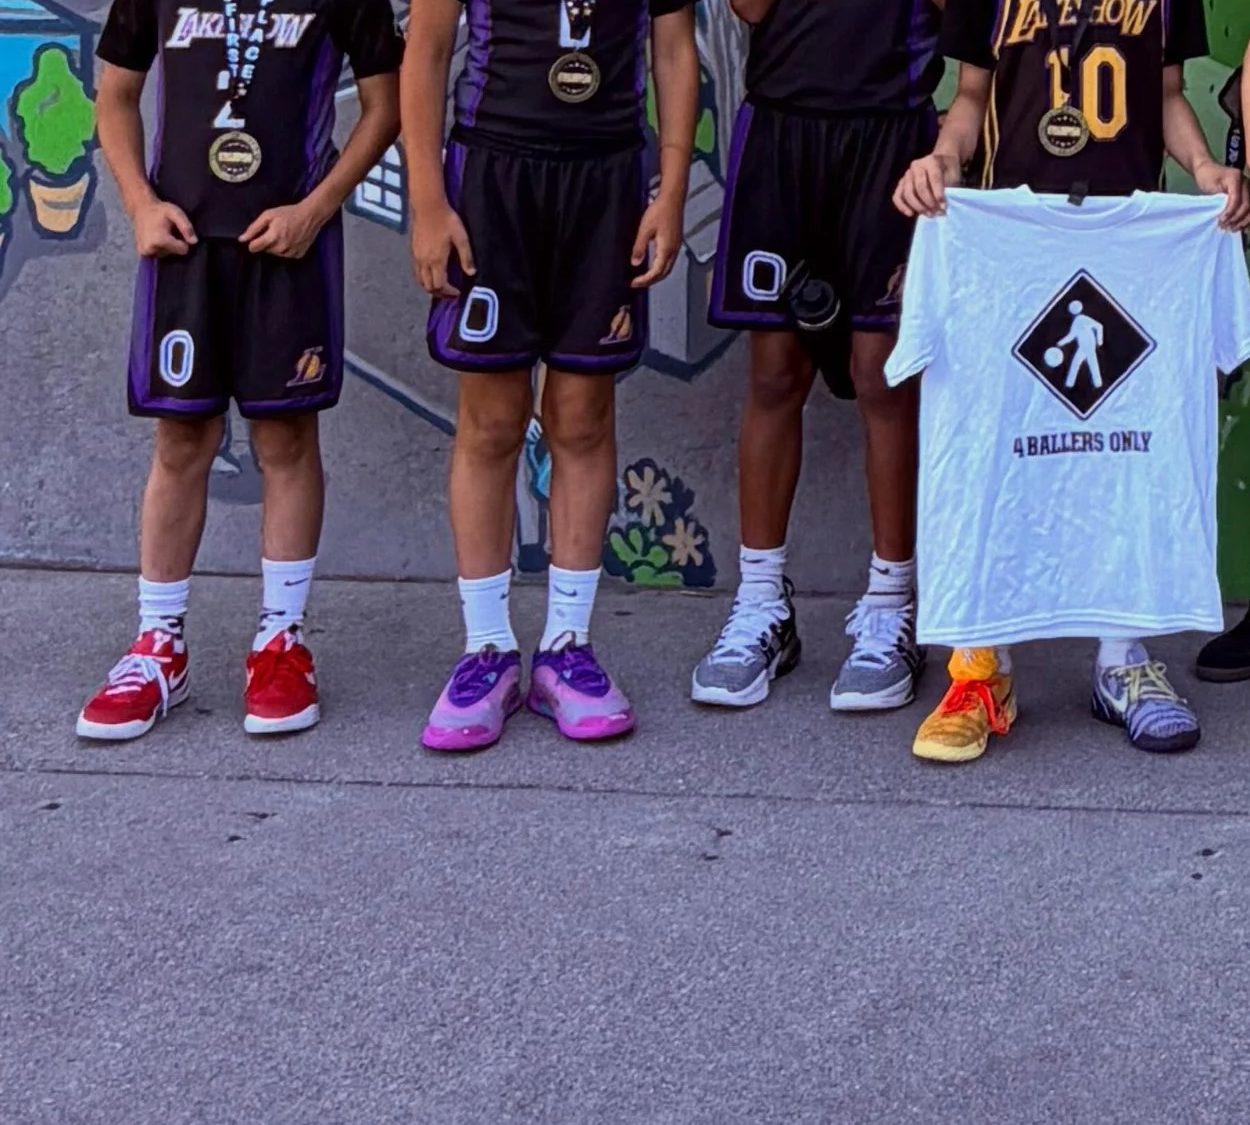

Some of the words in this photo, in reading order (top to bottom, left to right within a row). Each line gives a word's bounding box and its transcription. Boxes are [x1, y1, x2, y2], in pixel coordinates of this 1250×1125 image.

[165, 7, 317, 48] LAKOW
[1045, 42, 1128, 142] 10
[1013, 436, 1025, 458] 4
[1027, 431, 1104, 457] BALLERS
[1110, 430, 1152, 453] ONLY
